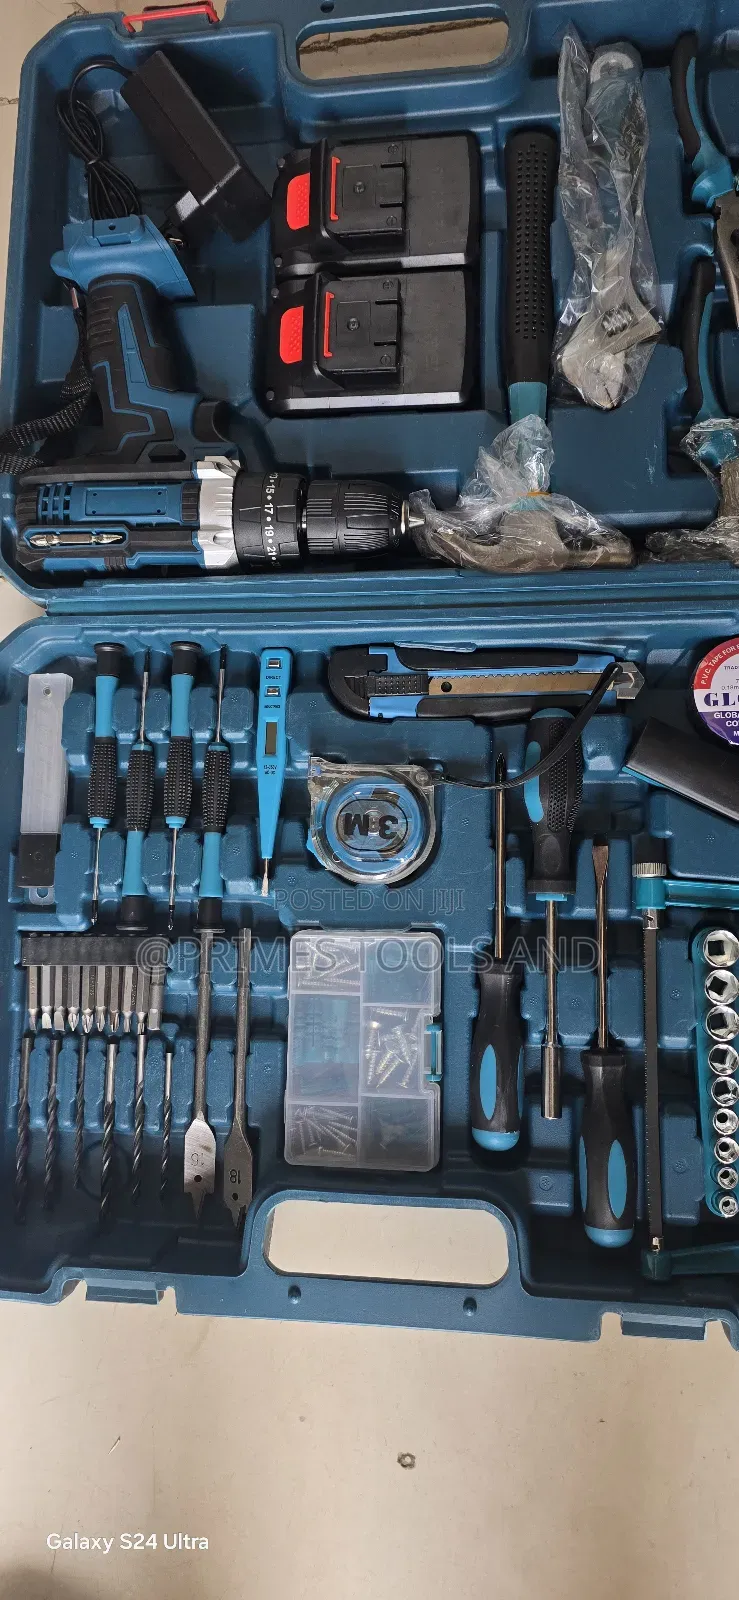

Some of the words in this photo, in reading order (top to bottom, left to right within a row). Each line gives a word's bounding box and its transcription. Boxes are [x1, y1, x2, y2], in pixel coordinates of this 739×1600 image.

[265, 484, 276, 494] 15
[264, 503, 274, 515] 17
[264, 525, 275, 537] 19
[266, 546, 278, 556] 21
[708, 653, 723, 667] TAPE
[721, 645, 737, 656] FOR
[703, 692, 739, 707] GL
[229, 1168, 242, 1185] 18
